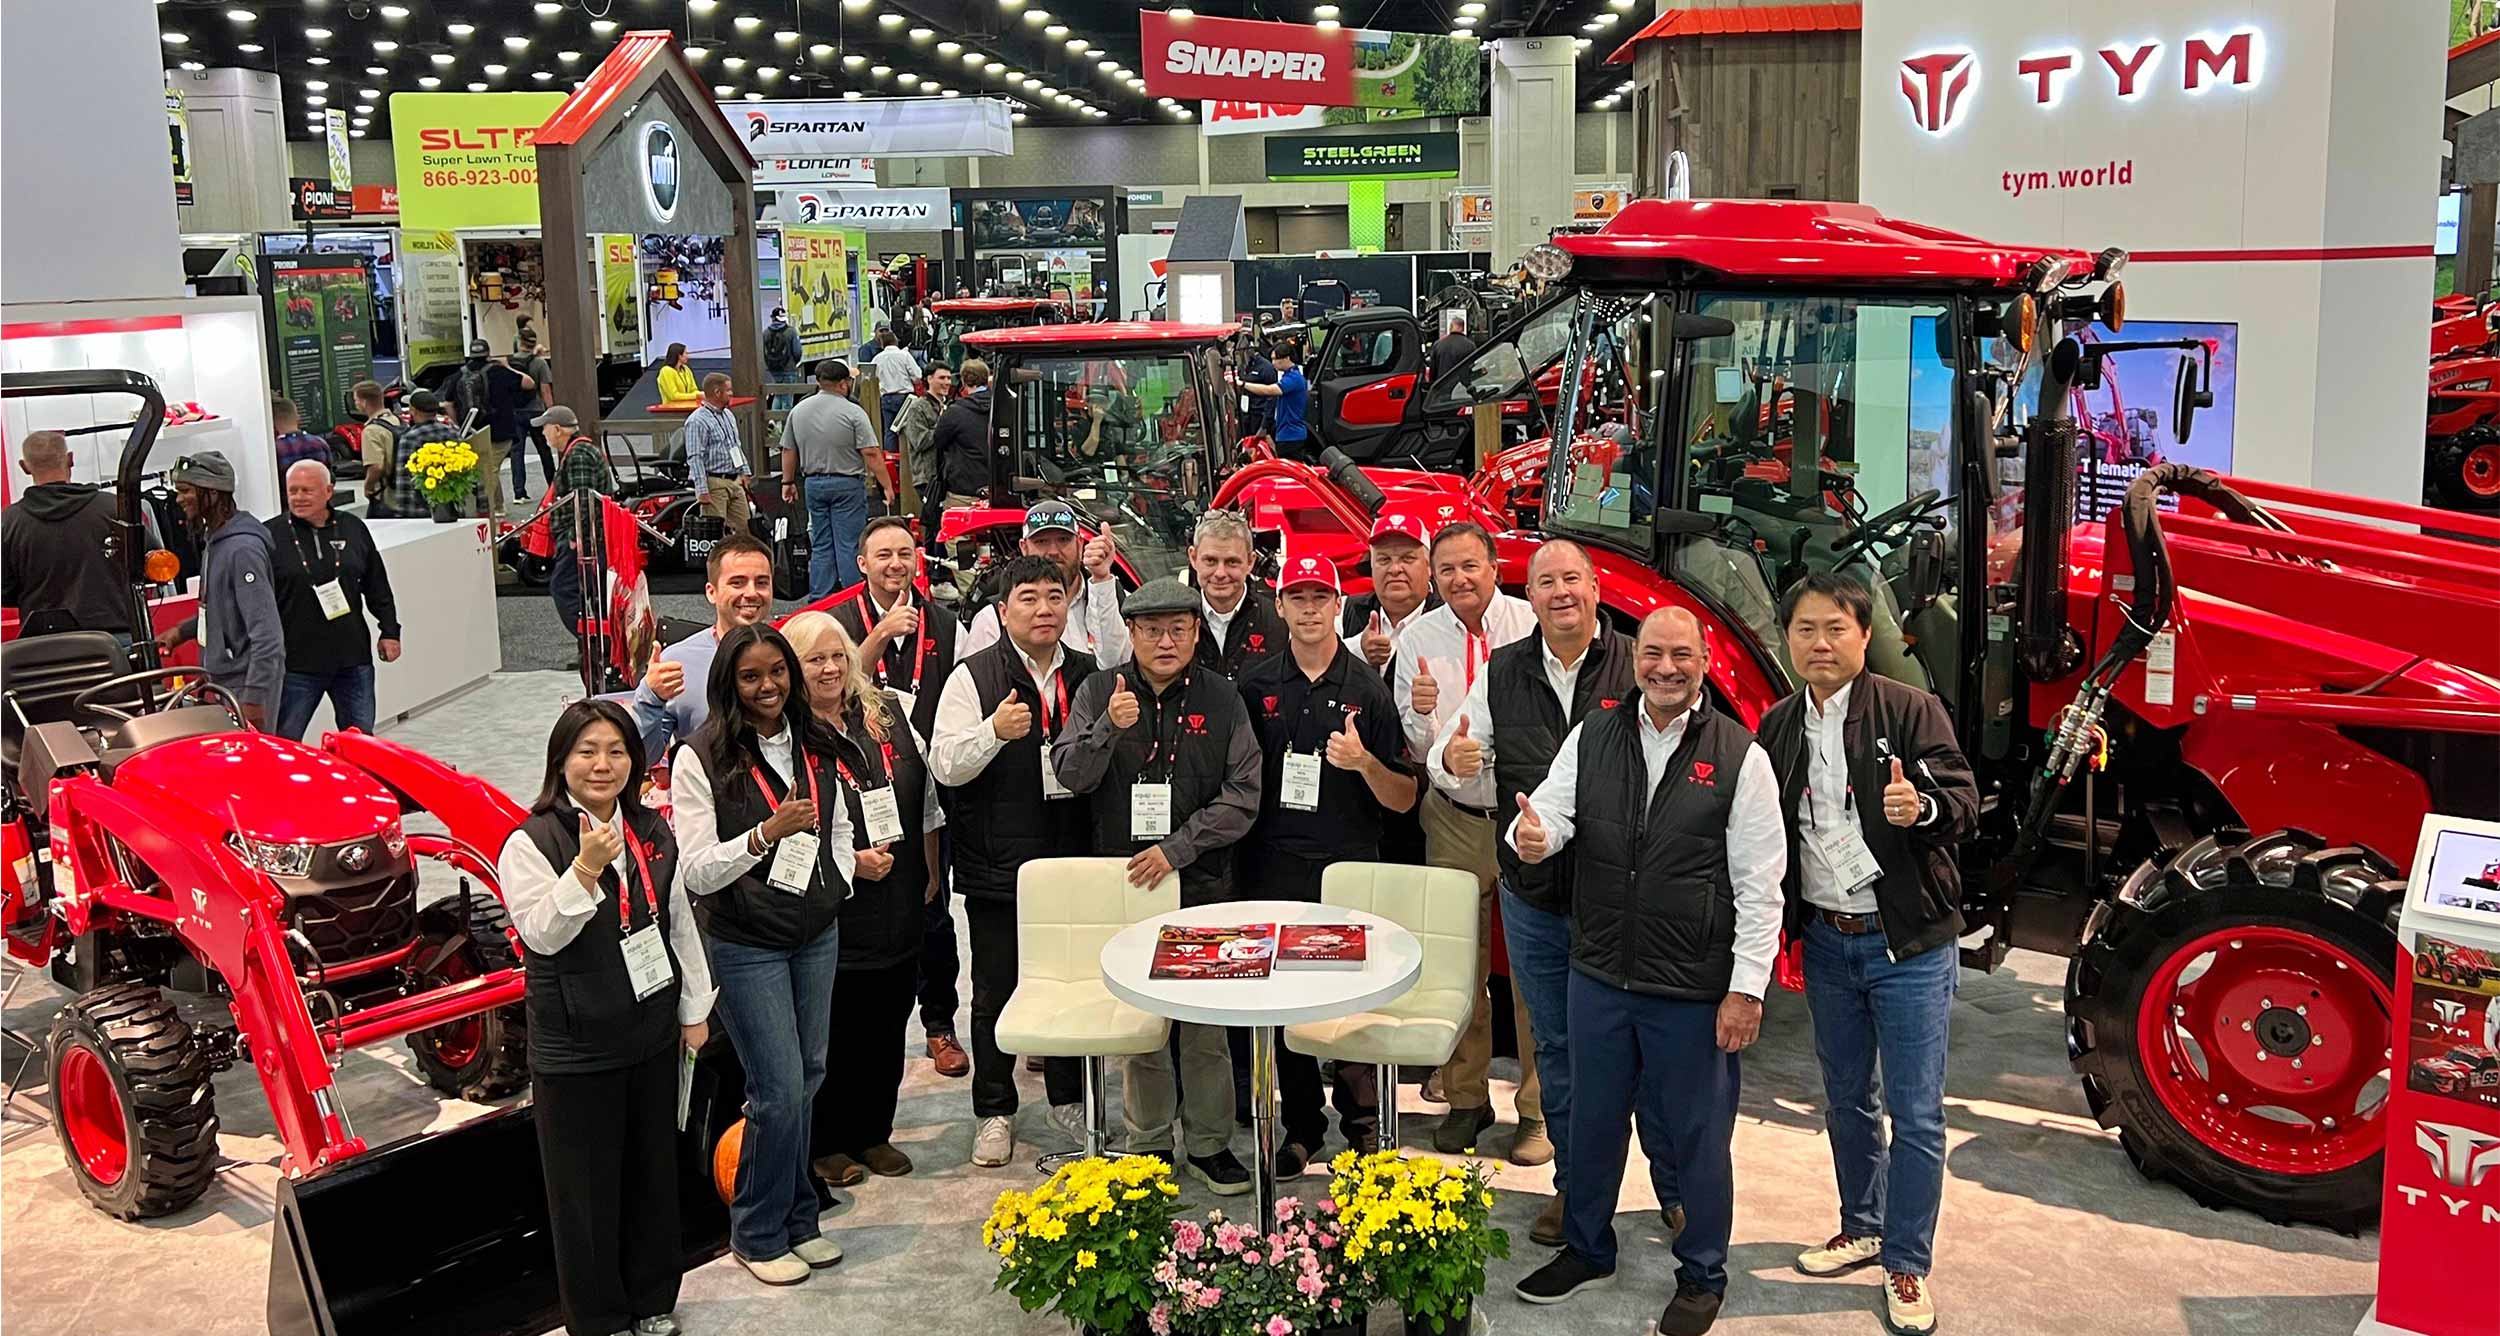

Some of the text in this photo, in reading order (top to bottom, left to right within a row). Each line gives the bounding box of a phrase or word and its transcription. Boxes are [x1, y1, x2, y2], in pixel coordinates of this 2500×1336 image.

[1165, 40, 1326, 82] SNAPPER
[2018, 34, 2254, 104] TYM
[769, 121, 865, 133] SPARTAN
[1303, 144, 1421, 159] STEELGREEN
[423, 153, 536, 167] Super Lawn Truc
[1304, 157, 1422, 166] MANUFACTURING
[2002, 160, 2133, 197] tym.world
[823, 205, 928, 218] SPARTAN
[2080, 457, 2151, 478] Tlematic
[2426, 1022, 2470, 1038] TYM
[2397, 1185, 2500, 1224] TYM
